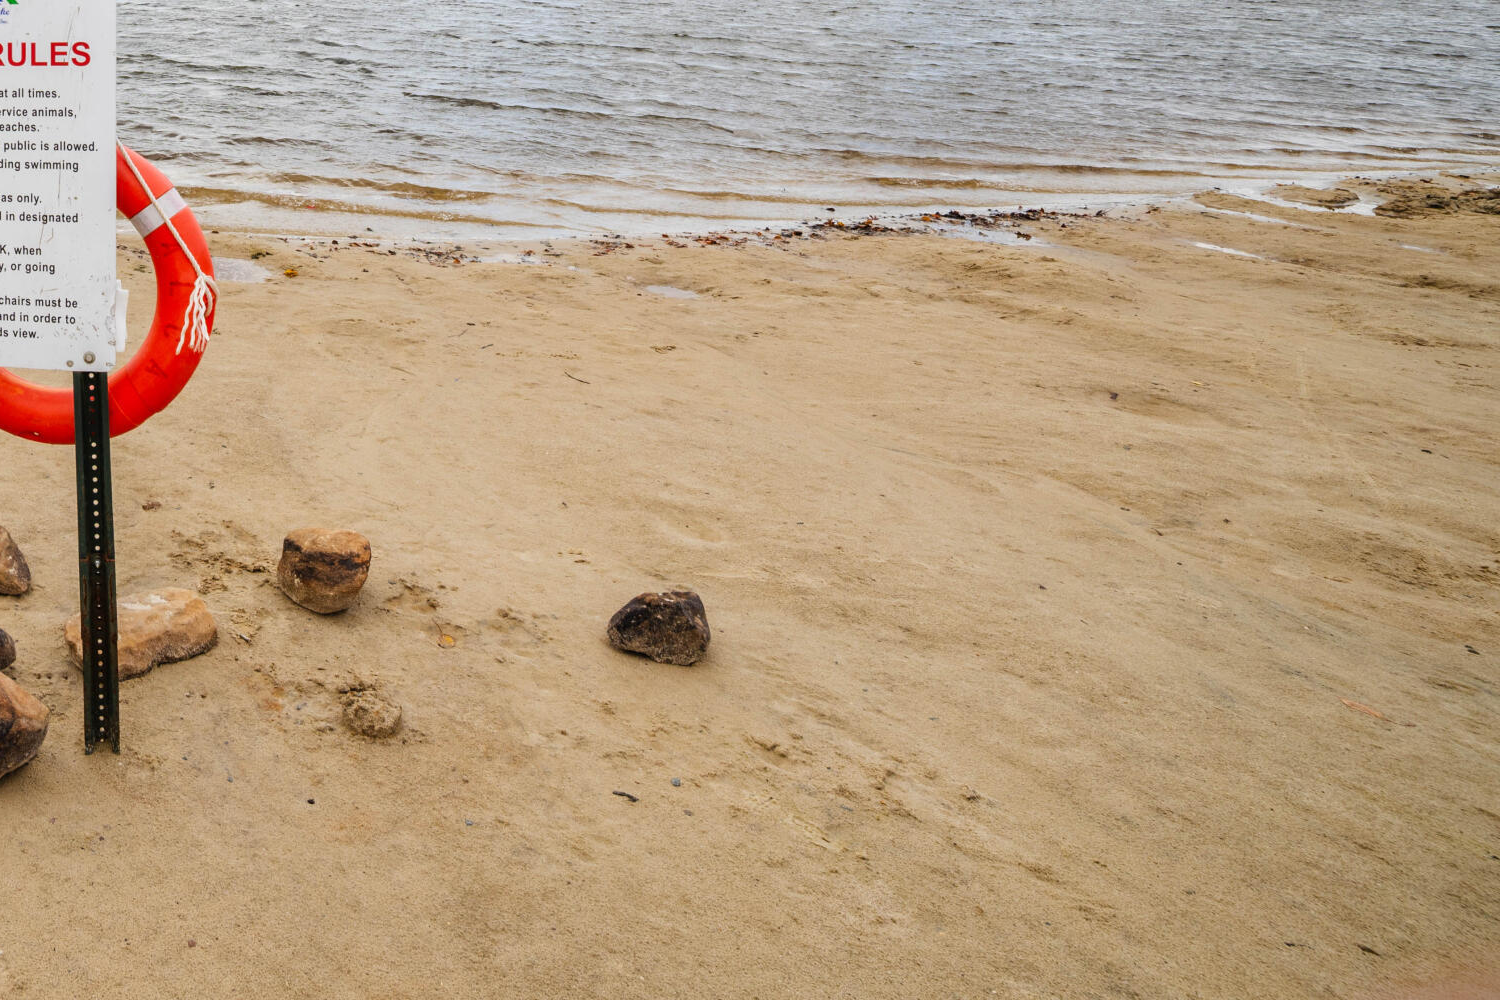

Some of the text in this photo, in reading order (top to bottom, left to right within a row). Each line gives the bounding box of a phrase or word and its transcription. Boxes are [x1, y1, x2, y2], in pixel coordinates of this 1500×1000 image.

[11, 87, 24, 99] all
[27, 87, 61, 99] times.
[31, 106, 77, 119] animals,
[3, 140, 37, 153] public
[40, 140, 50, 151] is
[53, 140, 98, 152] allowed.
[24, 159, 79, 173] swimming
[16, 192, 42, 206] only.
[5, 211, 16, 221] in
[18, 211, 79, 225] designated
[13, 245, 42, 256] when
[10, 263, 22, 271] or
[25, 262, 56, 275] going
[35, 297, 62, 308] must
[65, 297, 78, 309] be
[19, 311, 29, 322] in
[32, 313, 62, 324] order
[65, 314, 76, 325] to
[12, 327, 40, 339] view.
